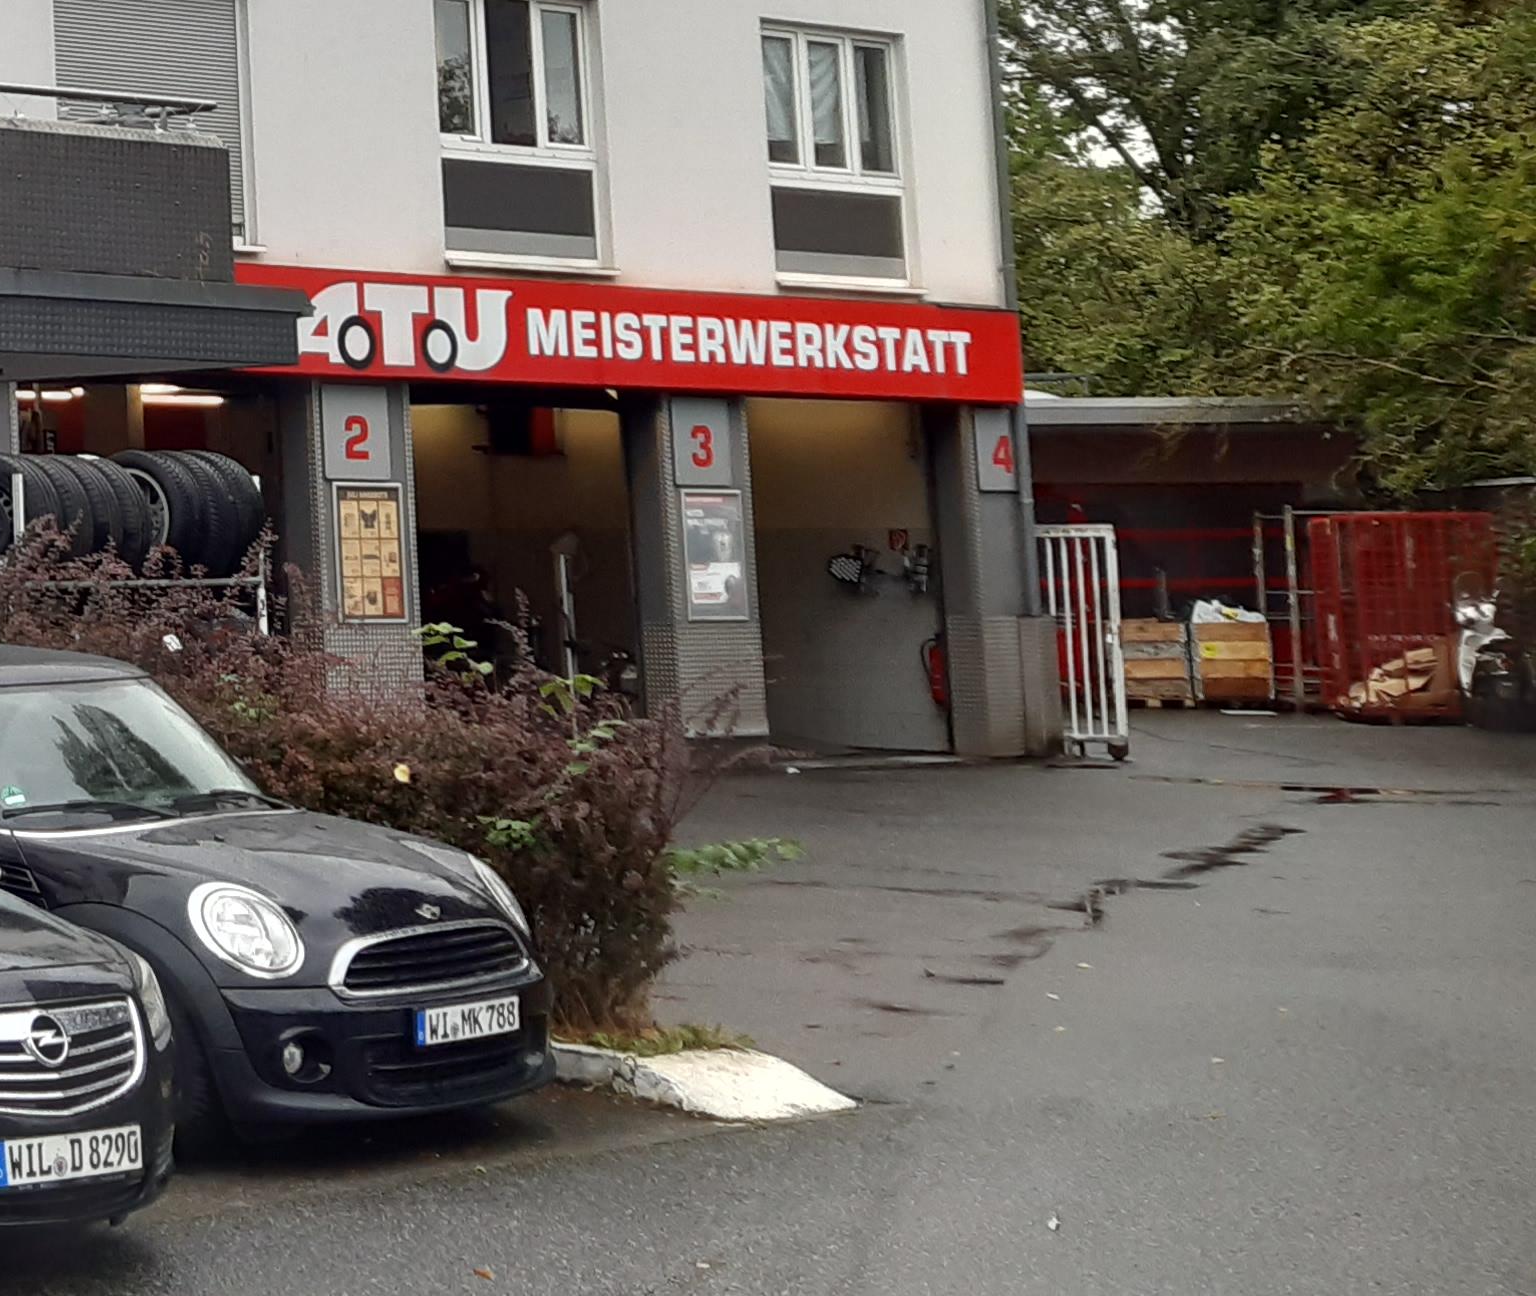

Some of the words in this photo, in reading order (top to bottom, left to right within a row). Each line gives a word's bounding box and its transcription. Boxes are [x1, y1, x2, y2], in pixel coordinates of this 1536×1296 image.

[528, 307, 971, 375] MEISTERWERKSTATT
[344, 414, 370, 460] 2
[690, 424, 714, 468] 3
[991, 435, 1014, 474] 4
[429, 1012, 449, 1041] WI
[461, 1007, 483, 1036] MK
[485, 1001, 516, 1032] 788
[8, 1142, 52, 1180] WIL
[69, 1138, 84, 1173] D
[89, 1130, 139, 1171] 8290
